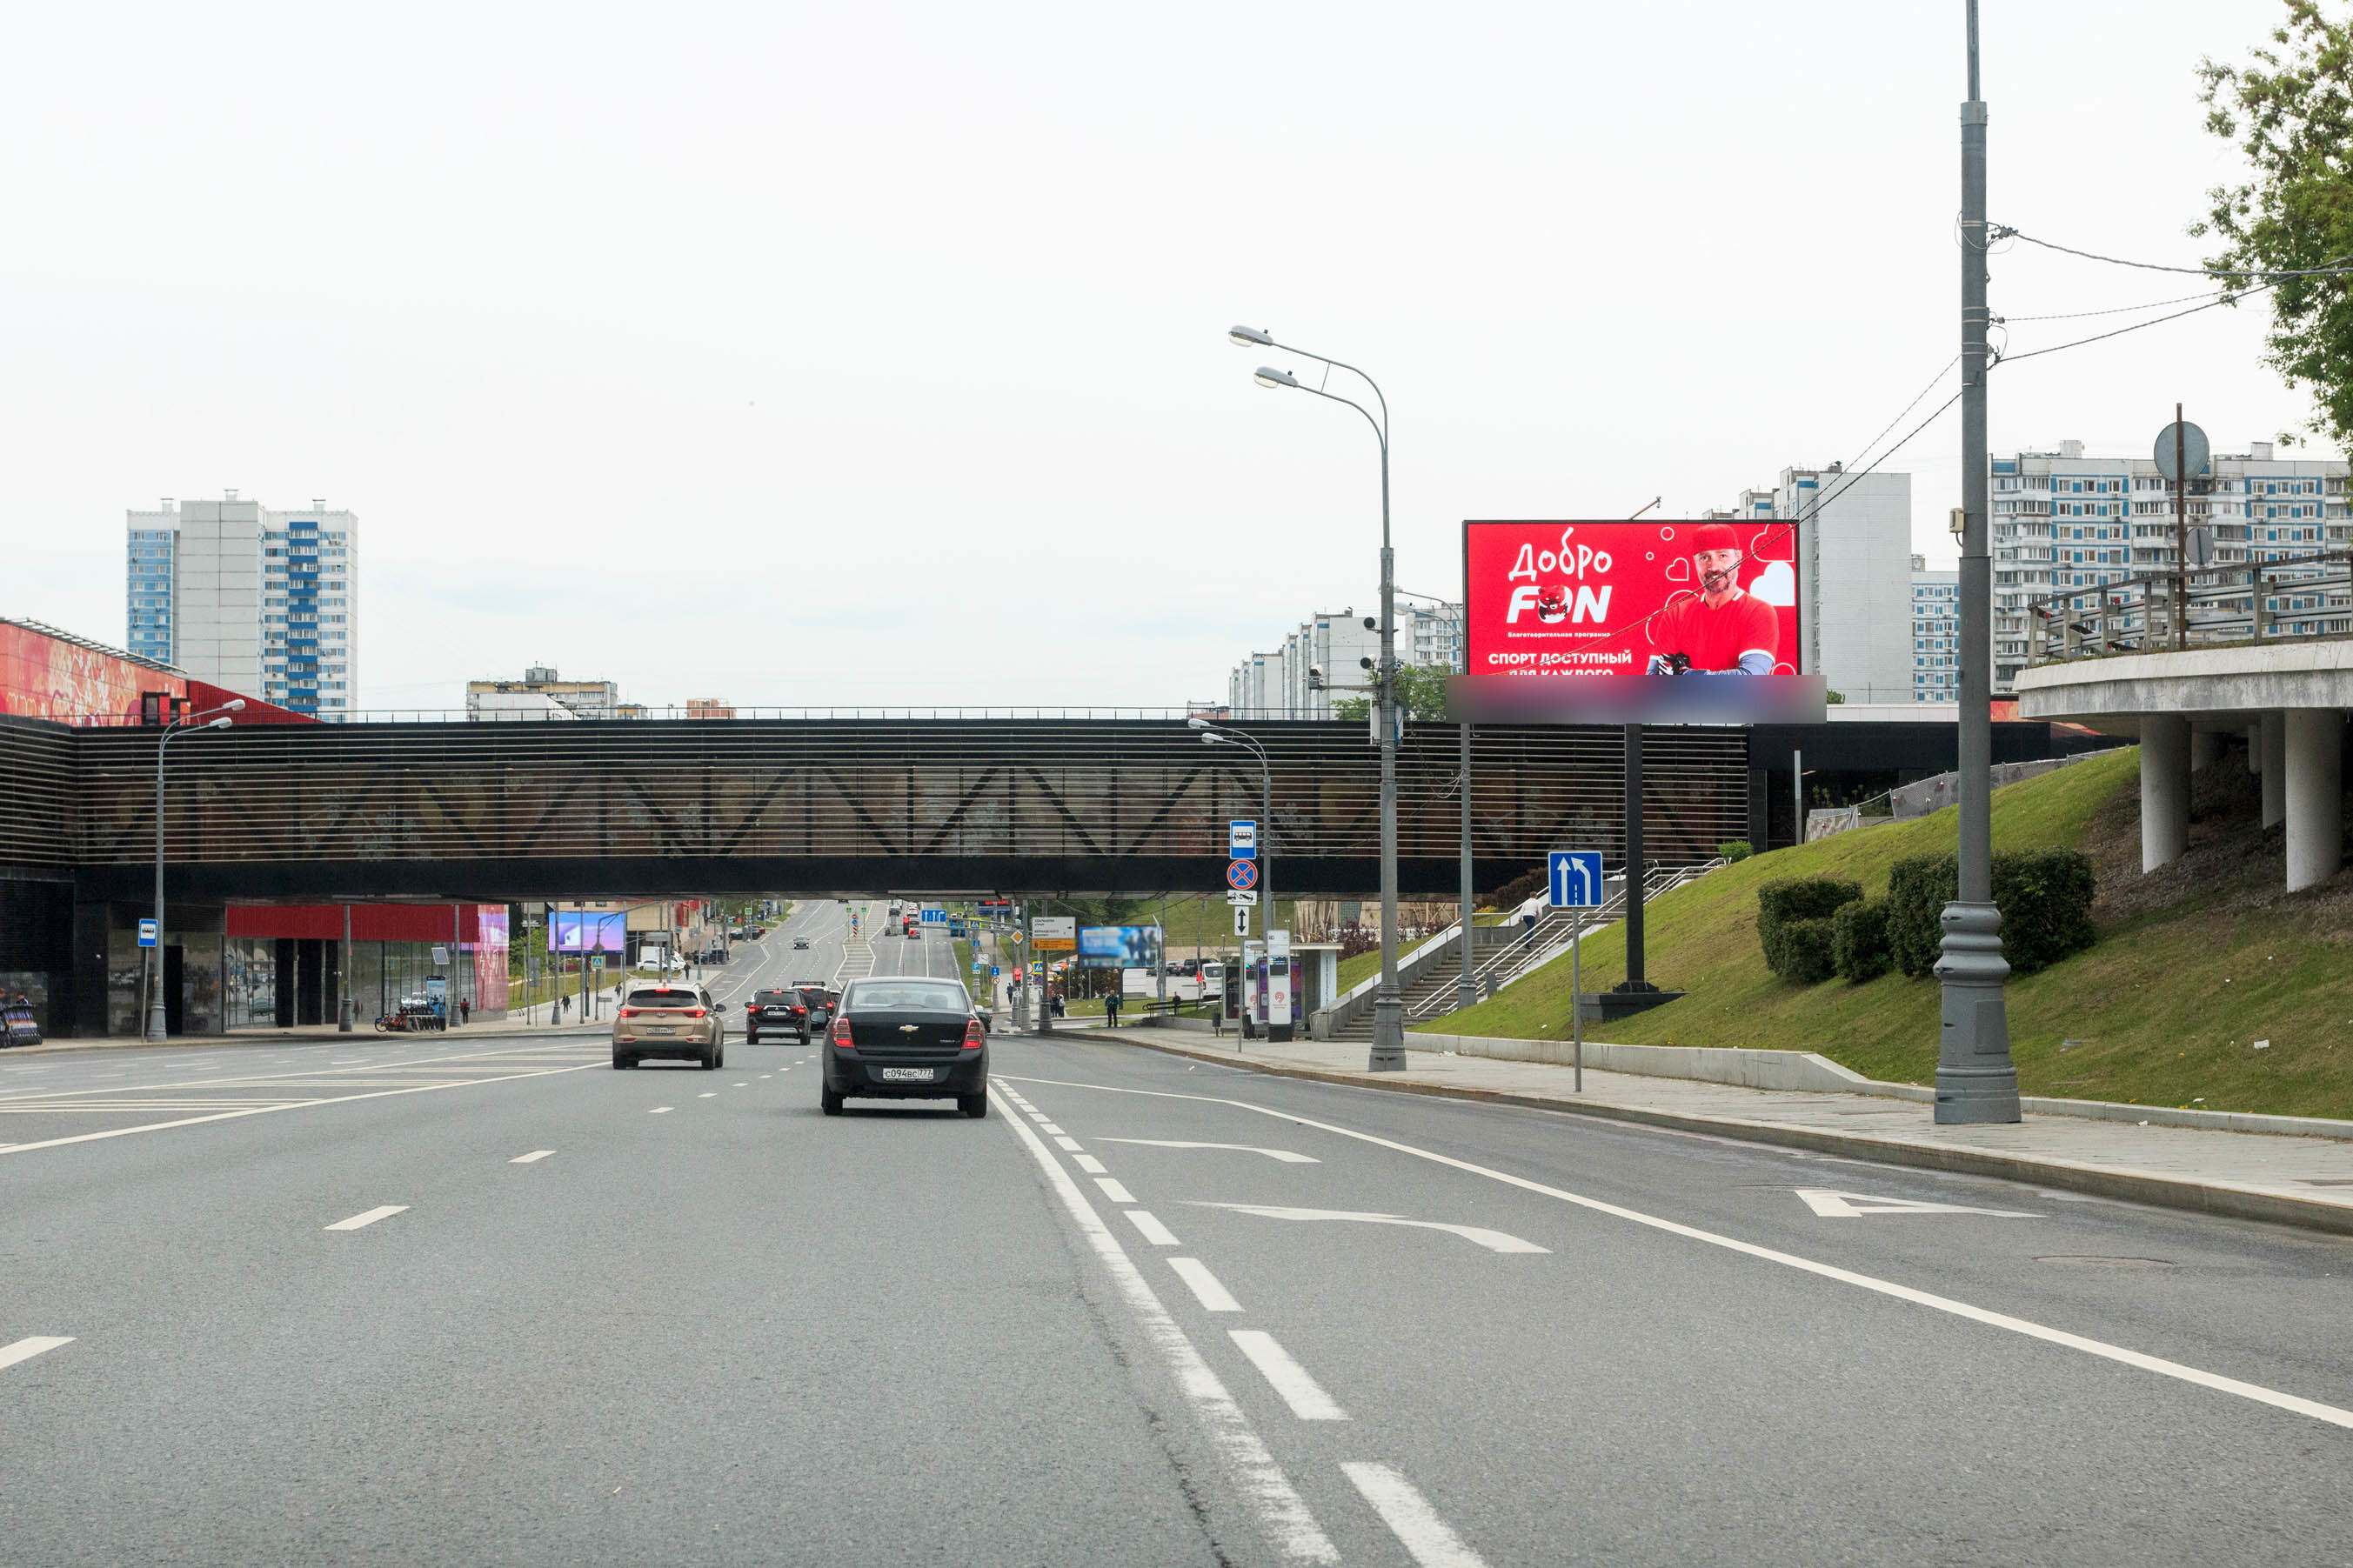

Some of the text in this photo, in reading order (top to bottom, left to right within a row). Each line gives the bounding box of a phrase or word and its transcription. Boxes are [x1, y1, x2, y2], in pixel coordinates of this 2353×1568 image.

[1508, 527, 1613, 582] Добро
[1488, 650, 1632, 665] СПОРТ ДОСТУПНЫЙ
